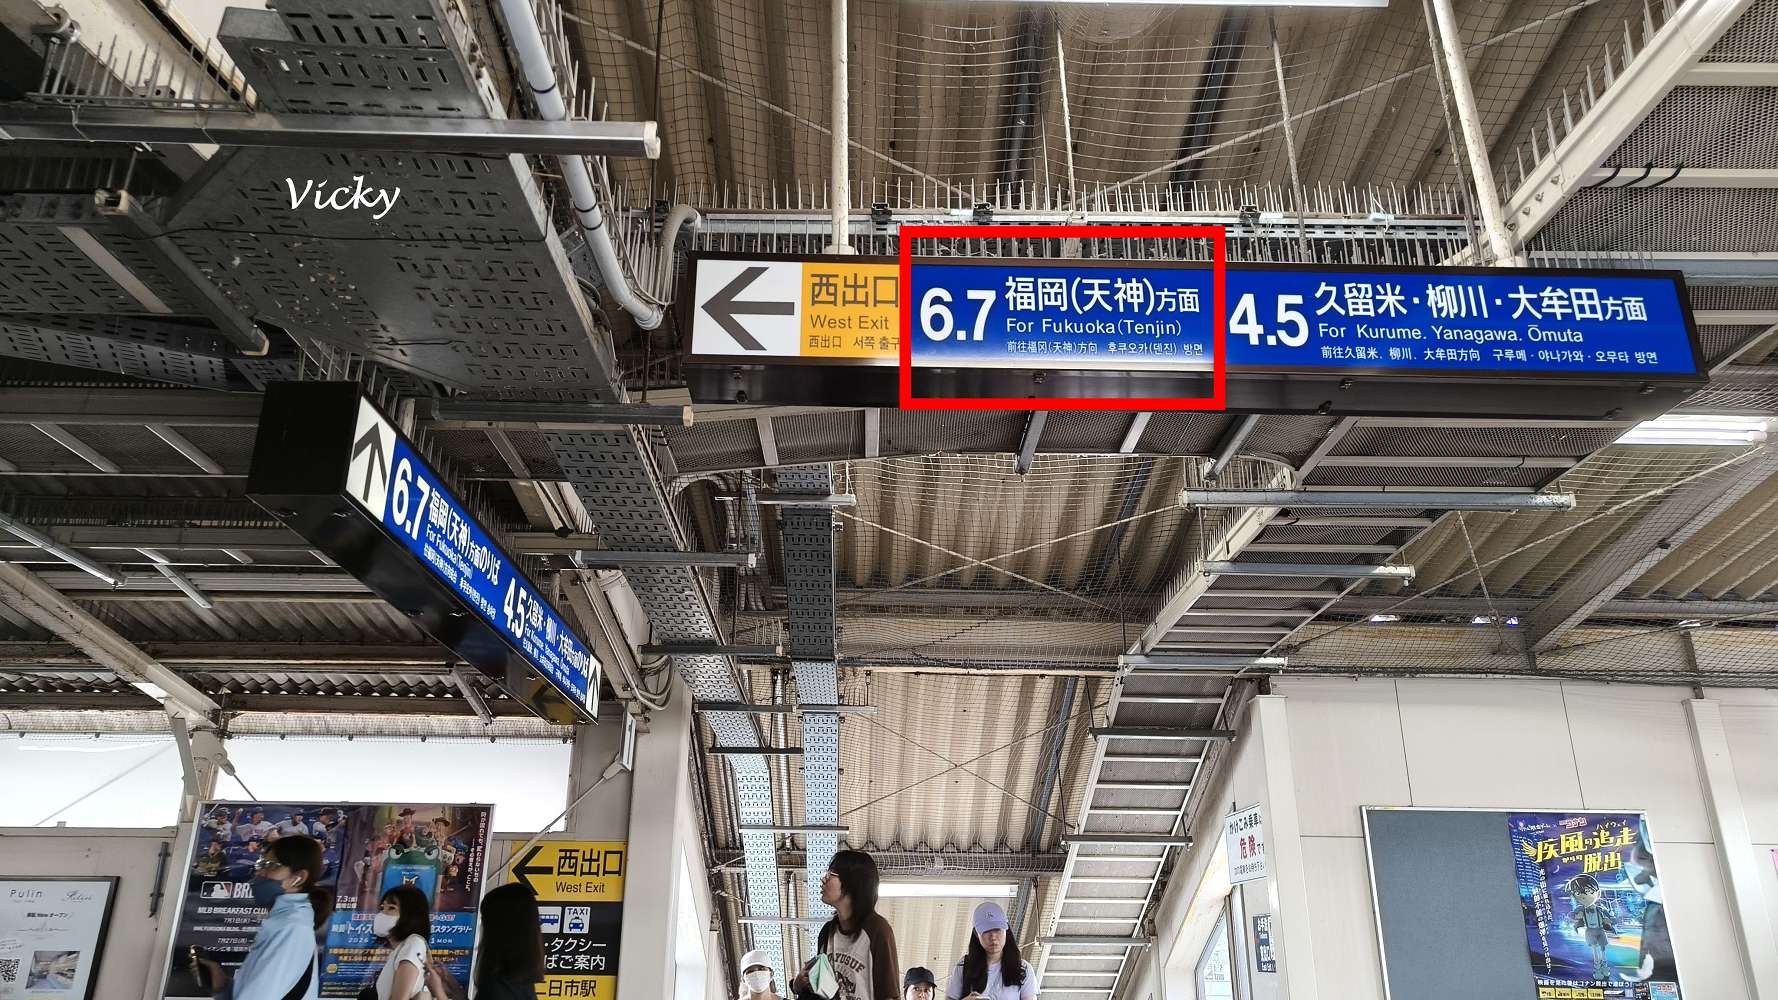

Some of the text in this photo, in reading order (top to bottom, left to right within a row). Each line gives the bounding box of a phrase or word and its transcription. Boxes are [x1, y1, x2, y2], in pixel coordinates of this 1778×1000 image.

[810, 273, 899, 308] 西出口
[1005, 276, 1200, 316] 福岡(天神)方面
[810, 314, 889, 330] West Exit
[919, 287, 996, 342] 6.7
[1229, 294, 1309, 348] 4.5
[1006, 318, 1182, 339] For Fukuoka(Tenjin)
[1319, 323, 1346, 338] For
[1527, 324, 1584, 343] Ōmuta
[809, 334, 842, 349] 西出口
[853, 335, 875, 350] 서쪽
[1183, 342, 1204, 356] 방면
[1635, 351, 1659, 365] 방면
[392, 458, 431, 541] 6.7
[426, 524, 437, 544] For
[503, 577, 527, 639] 4.5
[1535, 826, 1639, 863] 疾風の追走
[557, 848, 623, 877] 西出口
[556, 881, 605, 893] West Exit
[213, 906, 253, 915] BREAKFAST
[253, 907, 269, 915] CLU
[567, 907, 589, 916] TAXI
